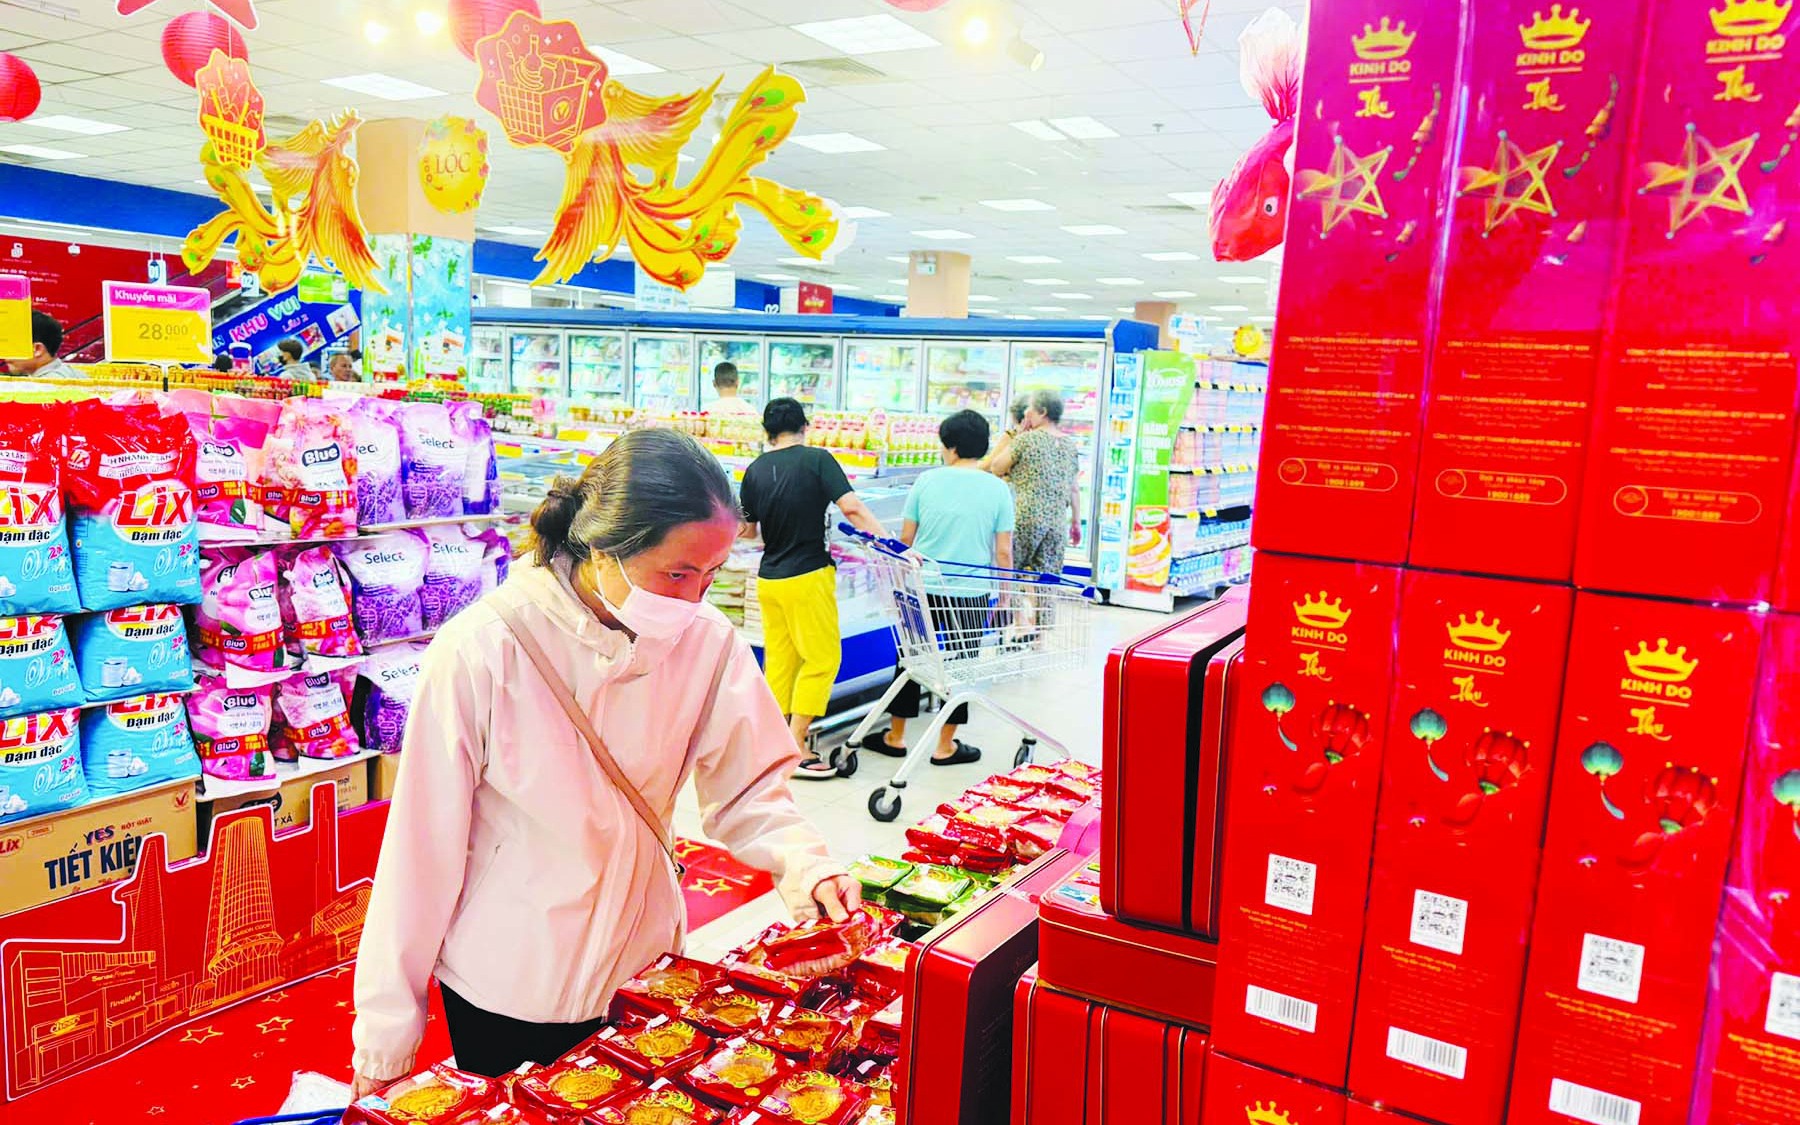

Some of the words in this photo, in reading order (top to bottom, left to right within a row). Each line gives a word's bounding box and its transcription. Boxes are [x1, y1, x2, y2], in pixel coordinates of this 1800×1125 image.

[1706, 37, 1753, 54] KINH
[1758, 34, 1786, 52] DO
[1516, 52, 1556, 66] KINH
[1561, 50, 1585, 64] DO
[1350, 62, 1385, 76] KINH
[1389, 60, 1411, 74] DO
[115, 289, 156, 304] Khuyến
[229, 313, 268, 343] KHU
[267, 295, 301, 321] VUI
[418, 434, 455, 449] Select
[304, 447, 338, 464] Blue
[365, 552, 405, 564] Select
[226, 640, 245, 648] Blue
[1291, 627, 1324, 641] KINH
[1327, 631, 1348, 644] DO
[1297, 651, 1333, 682] Thu
[1444, 649, 1480, 664] KINH
[1483, 655, 1506, 668] DO
[306, 674, 328, 689] Blue
[1620, 678, 1663, 697] KINH
[1665, 682, 1692, 699] DO
[1449, 674, 1489, 707] Thu
[227, 695, 256, 708] Blue
[1626, 706, 1672, 741] Thu
[216, 742, 237, 751] Blue
[84, 824, 115, 846] YES
[44, 842, 93, 890] TIẾT
